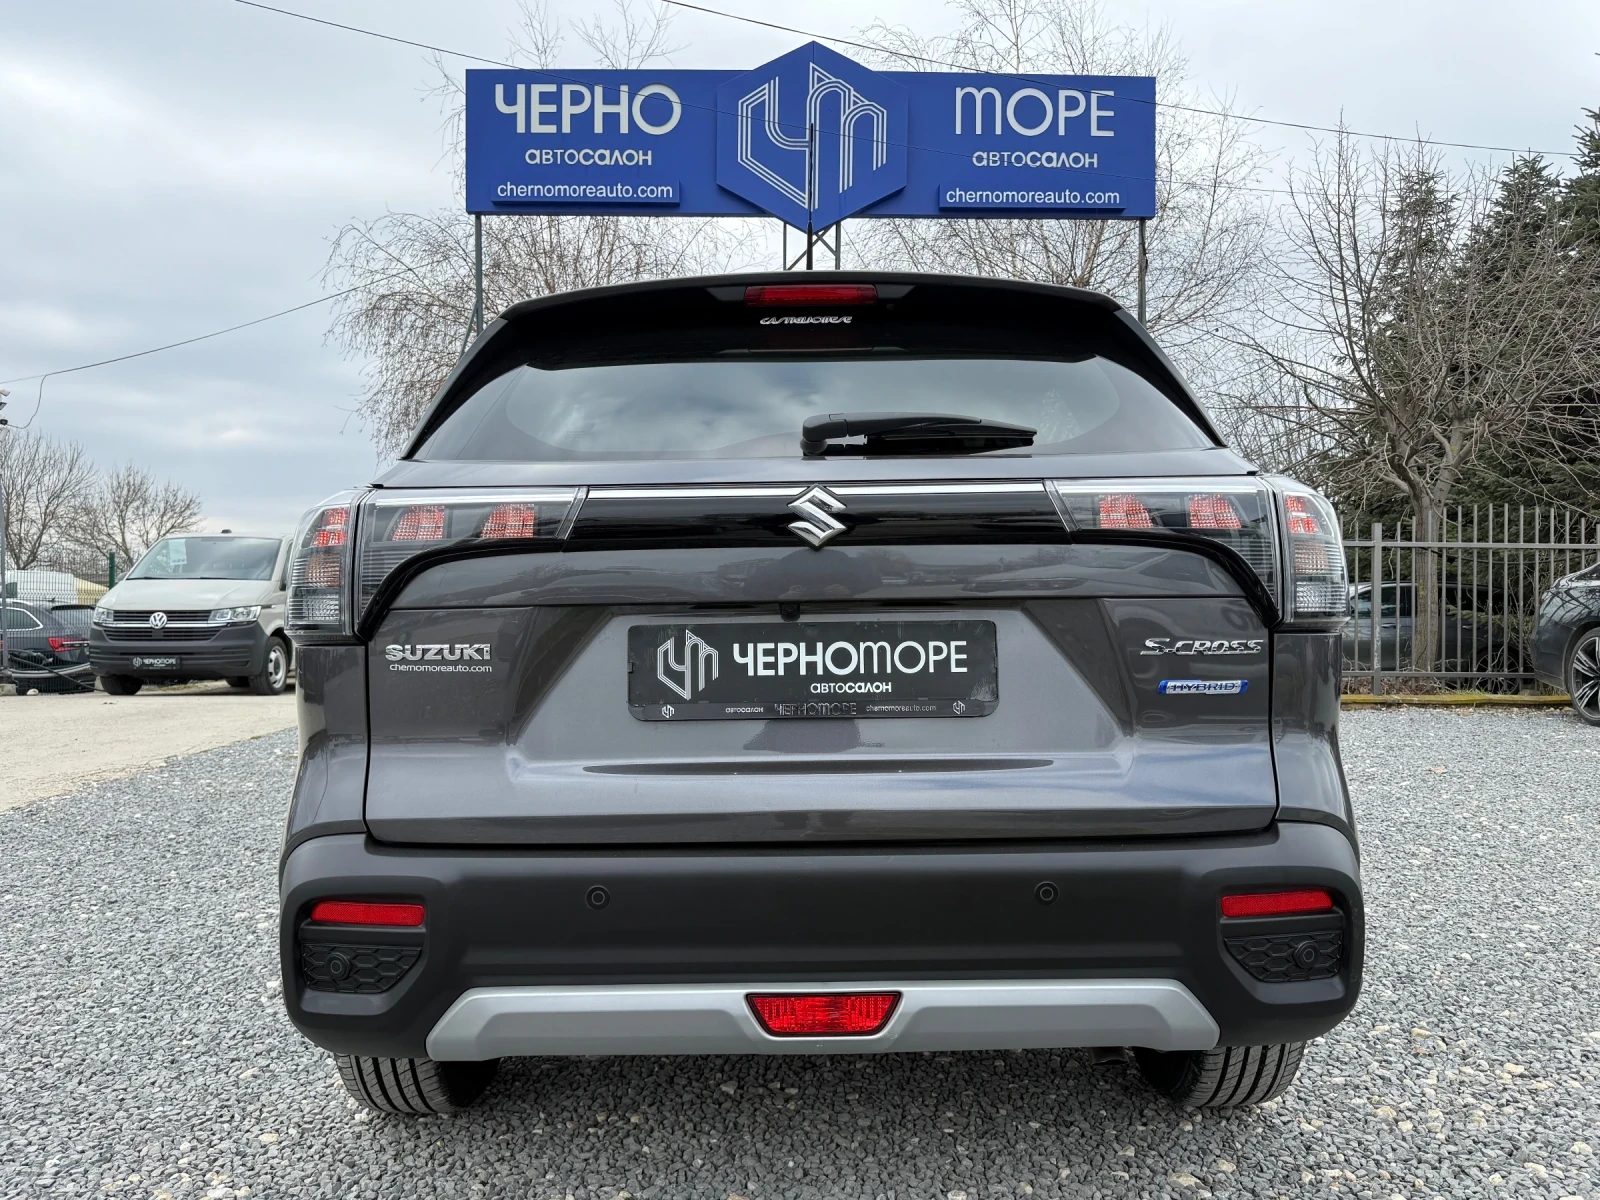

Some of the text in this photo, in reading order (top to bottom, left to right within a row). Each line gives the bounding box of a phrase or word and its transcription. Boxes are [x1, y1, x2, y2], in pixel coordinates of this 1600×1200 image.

[494, 83, 682, 135] ЧЕРНО
[955, 87, 1115, 137] МОРЕ
[525, 148, 652, 166] автосалон
[972, 151, 1098, 168] автосалон
[497, 181, 673, 199] chernomoreauto.com
[946, 187, 1120, 205] chernomoreauto.com
[385, 644, 491, 661] SUZUKI
[1140, 638, 1264, 655] S-CROSS
[733, 640, 968, 676] ЧЕРНОМОРЕ
[389, 663, 493, 672] chernomoreauto.com
[810, 681, 892, 694] автосалон
[1169, 682, 1239, 692] HYBRID
